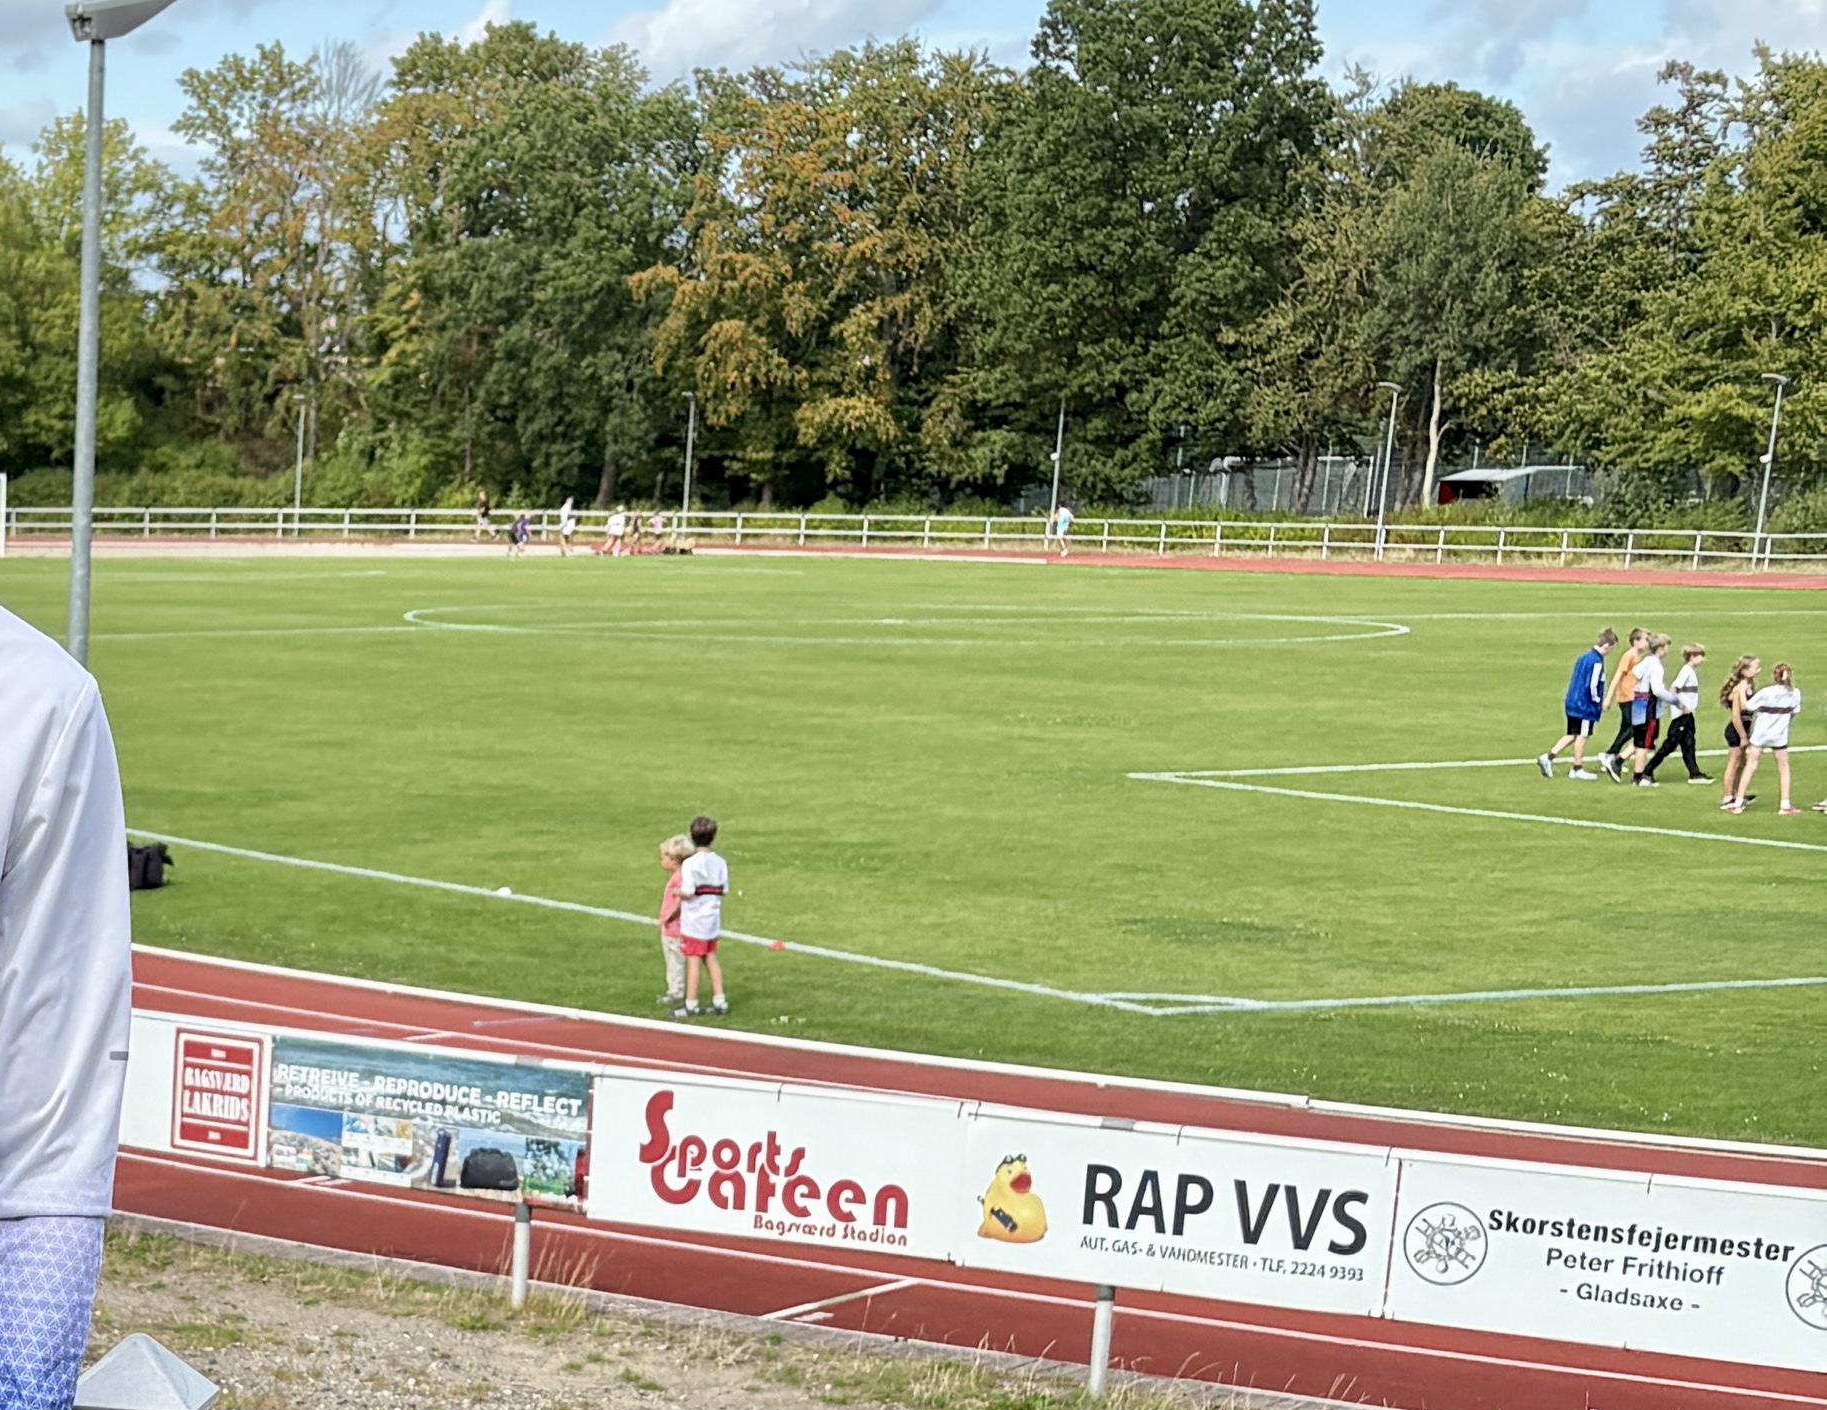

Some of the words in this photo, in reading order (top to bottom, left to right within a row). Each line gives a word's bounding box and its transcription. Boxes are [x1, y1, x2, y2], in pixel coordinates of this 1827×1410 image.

[182, 1089, 250, 1122] LAKRIDS
[278, 1063, 360, 1088] RETREIVE
[374, 1075, 482, 1104] REPRODUCE
[496, 1091, 583, 1117] REFLECT
[285, 1084, 354, 1103] PRODUCTS
[355, 1092, 373, 1107] OF
[375, 1096, 443, 1117] RECYCLED
[444, 1104, 501, 1124] PLASTIC
[639, 1090, 806, 1178] Sports
[650, 1145, 909, 1229] Cafeen
[1082, 1163, 1214, 1236] RAP
[1233, 1178, 1370, 1256] VVS
[753, 1214, 836, 1238] Bagsværd
[842, 1223, 908, 1246] Stadion
[1488, 1209, 1796, 1263] Skorstensfejermester
[1160, 1245, 1248, 1270] VANDMESTER
[1290, 1261, 1326, 1278] 2224
[1330, 1266, 1364, 1281] 9393
[1546, 1248, 1614, 1274] Peter
[1622, 1256, 1726, 1286] Frithioff
[1576, 1283, 1684, 1312] Gladsaxe
